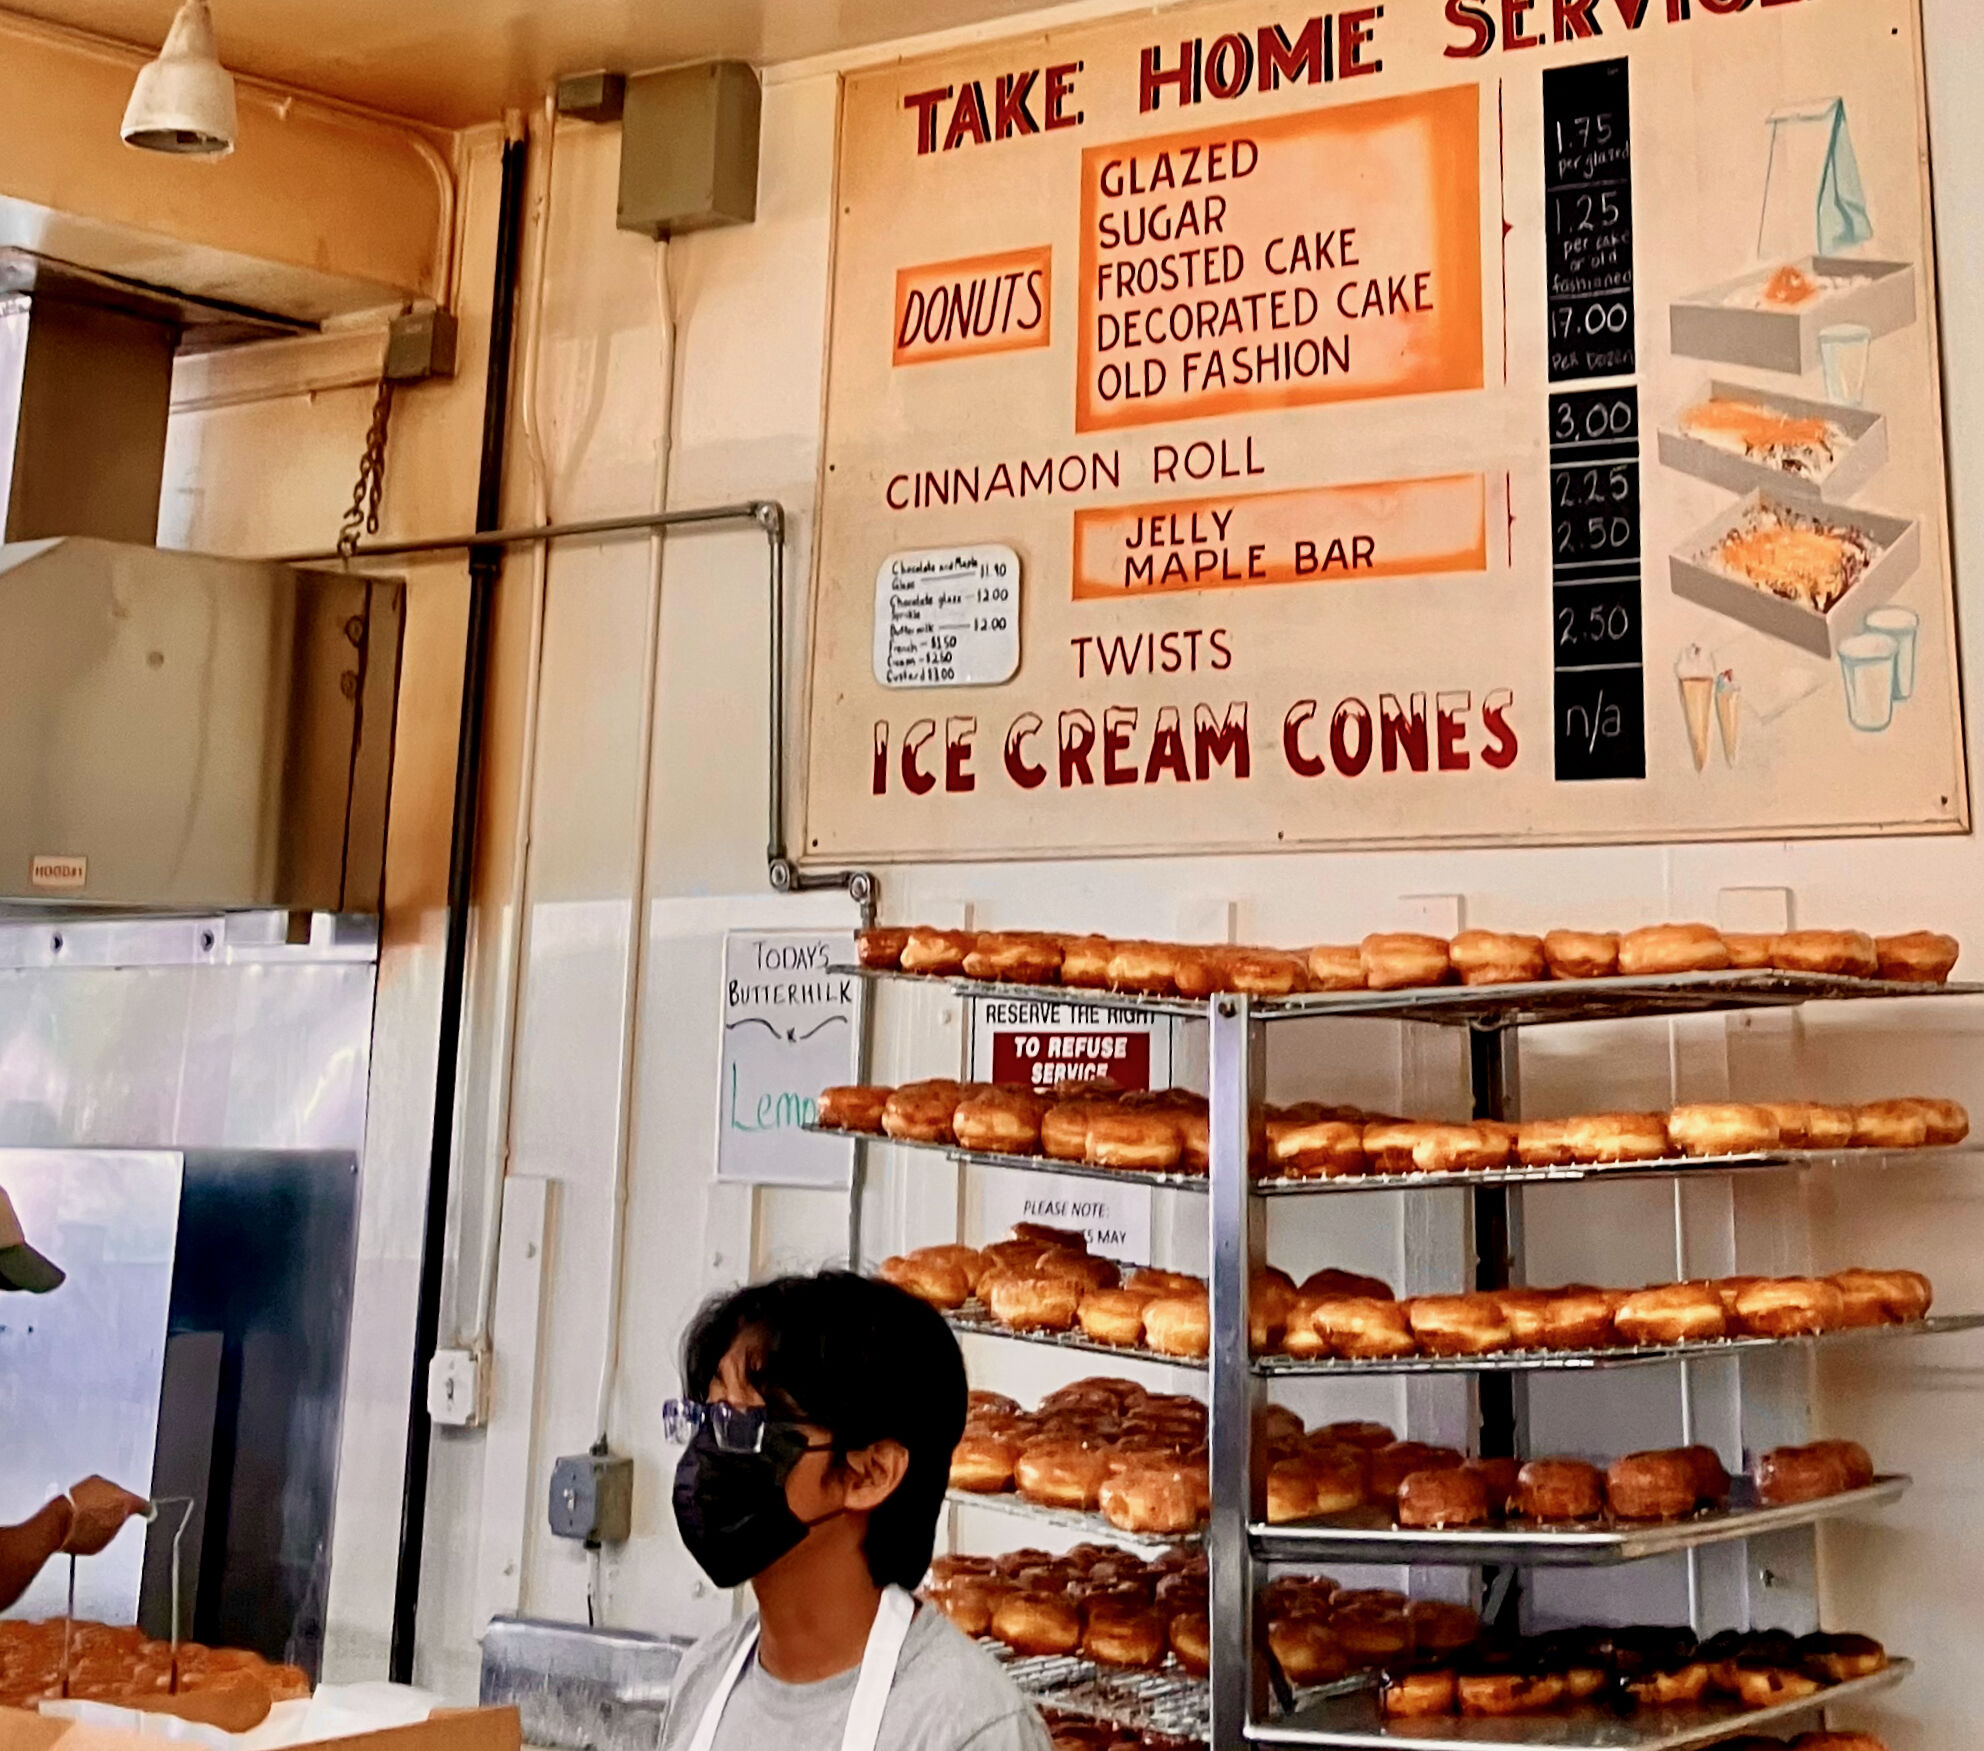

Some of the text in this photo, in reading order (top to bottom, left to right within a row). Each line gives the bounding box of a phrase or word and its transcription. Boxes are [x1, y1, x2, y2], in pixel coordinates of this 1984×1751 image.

[903, 61, 1085, 155] TAKE
[1139, 5, 1385, 114] HOME
[1556, 112, 1613, 155] 1.75
[1099, 138, 1259, 198] GLAZED
[1559, 155, 1582, 180] per
[1098, 195, 1227, 248] SUGAR
[1555, 191, 1620, 235] 1.25
[1097, 228, 1361, 302] FROSTED CAKE
[1563, 236, 1588, 261] per
[1590, 248, 1618, 269] old
[898, 269, 1043, 350] DONUTS
[1097, 272, 1434, 352] DECORATED CAKE
[1552, 302, 1628, 339] 17.00
[1097, 335, 1351, 401] OLD FASHION
[1555, 401, 1632, 441] 3.00
[886, 436, 1266, 511] CINNAMON ROLL
[1556, 465, 1629, 507] 2.25
[1125, 509, 1235, 549] JELLY
[1557, 516, 1630, 553] 2.50
[1124, 535, 1377, 590] MAPLE BAR
[1558, 605, 1629, 647] 2.50
[1070, 629, 1234, 679] TWISTS
[873, 687, 1520, 796] ICE CREAM CONES
[1566, 690, 1622, 755] n/a
[752, 940, 829, 970] TODAY'S
[728, 979, 853, 1007] BUTTERMILK
[986, 1003, 1156, 1025] RESERVE THE RIGHT
[1014, 1036, 1128, 1059] TO REFUSE
[1031, 1061, 1109, 1085] SERVICE
[1023, 1199, 1067, 1217] PLEASE
[1097, 1229, 1127, 1245] MAY
